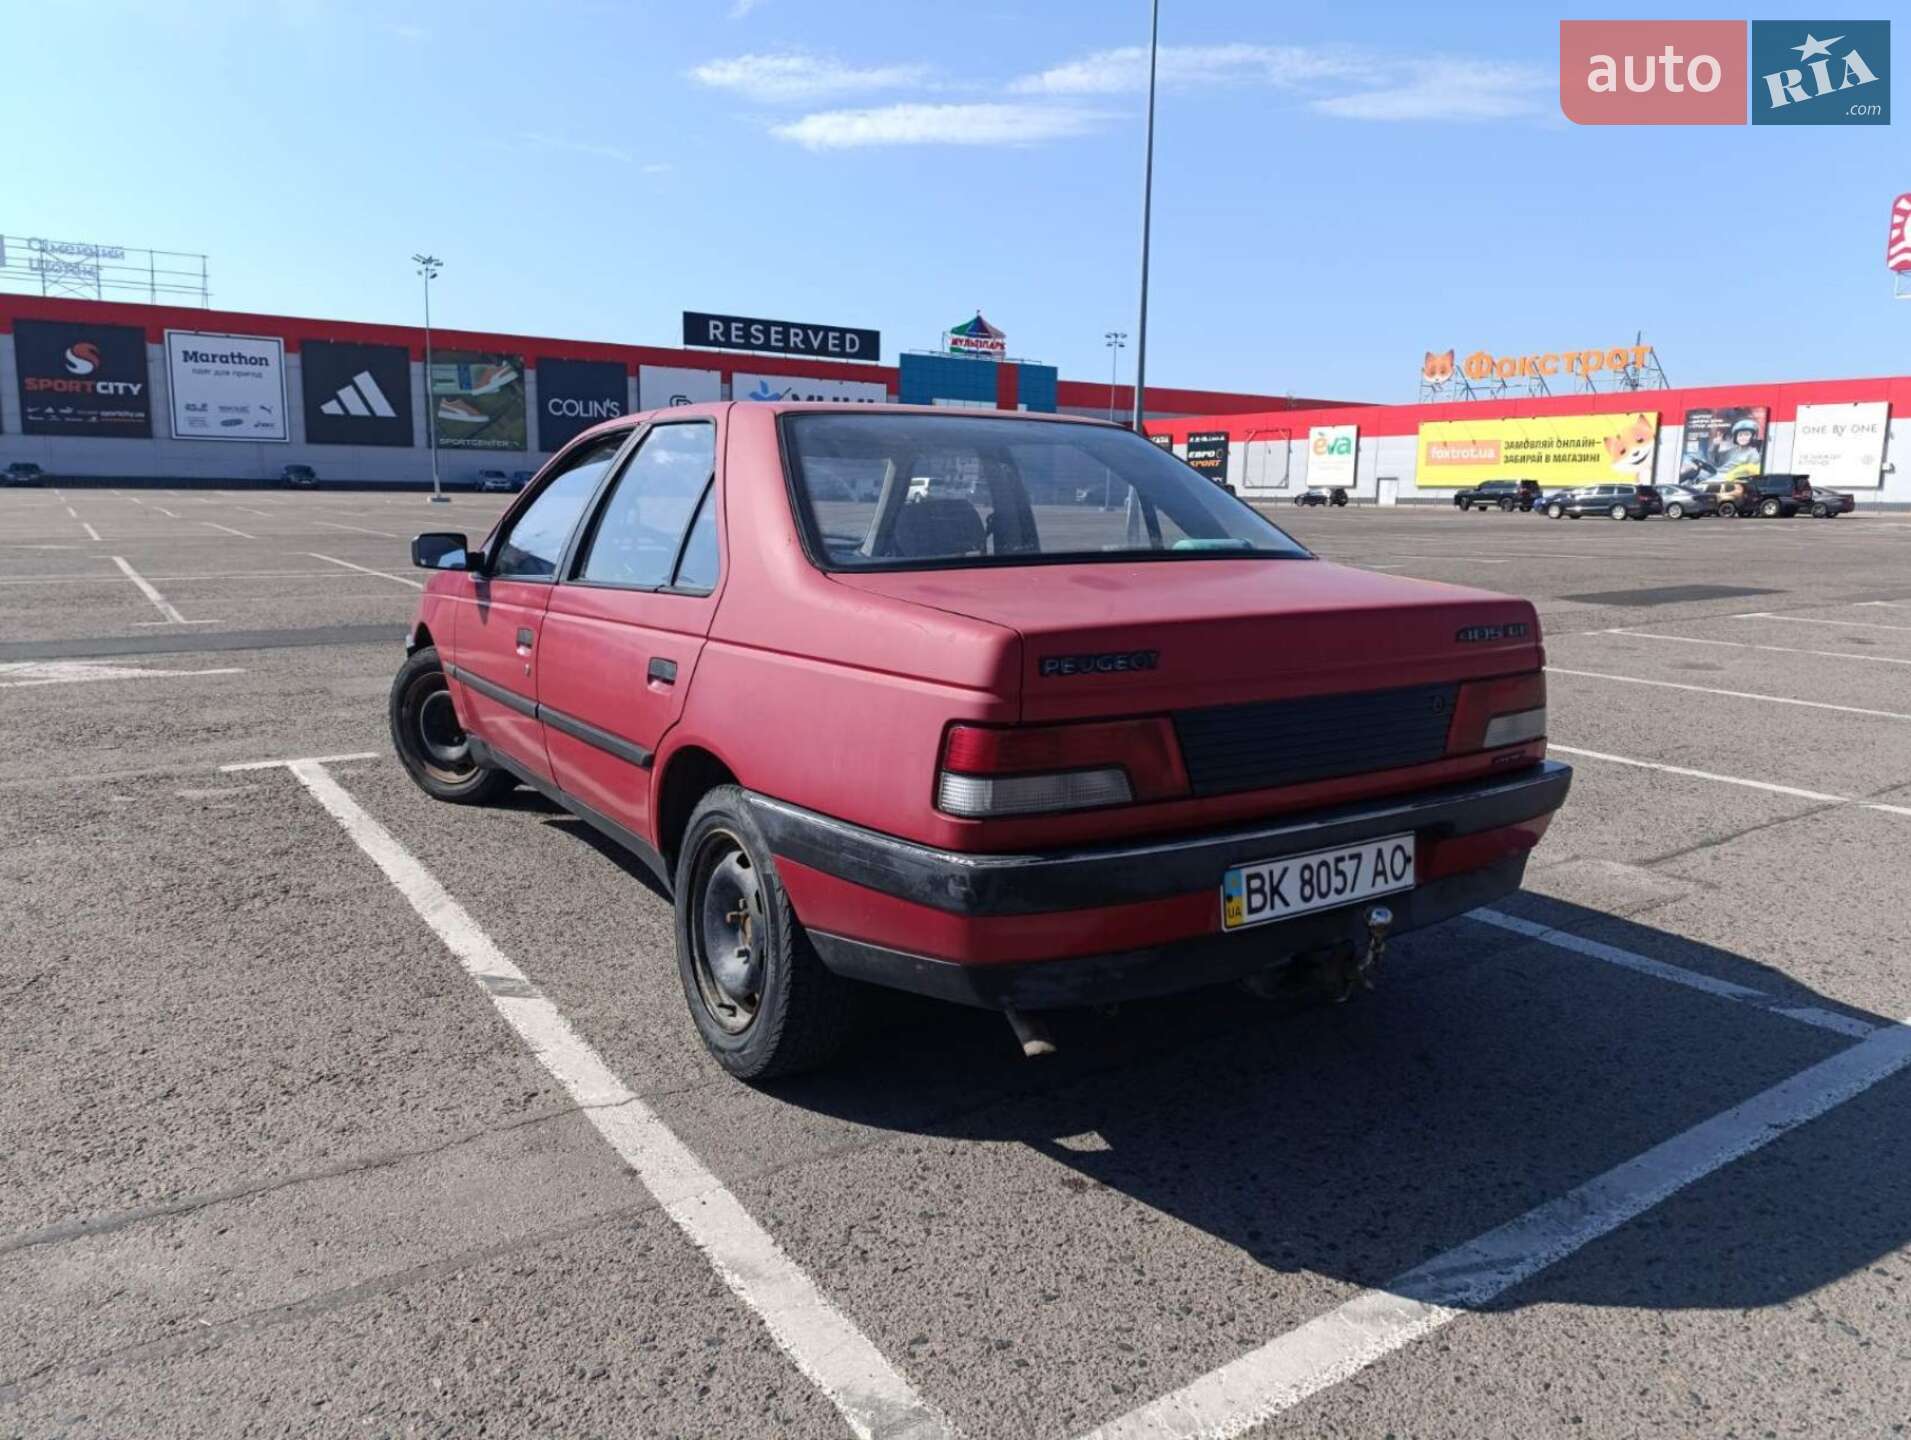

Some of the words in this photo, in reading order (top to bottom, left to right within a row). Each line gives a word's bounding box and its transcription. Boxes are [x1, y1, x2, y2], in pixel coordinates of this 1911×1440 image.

[708, 319, 861, 353] RESERVED
[182, 350, 270, 366] Marathon
[1464, 346, 1652, 380] Фокстрот
[24, 376, 143, 396] SPORTCITY
[548, 398, 621, 418] COLIN'S
[1802, 425, 1828, 434] ONE
[1832, 424, 1847, 437] BY
[1851, 423, 1878, 433] ONE
[1503, 452, 1543, 464] ЗАБИРАЙ
[1042, 651, 1159, 675] PEUGEOT
[1246, 866, 1291, 915] BK
[1299, 852, 1363, 903] 8057
[1371, 844, 1408, 888] AO
